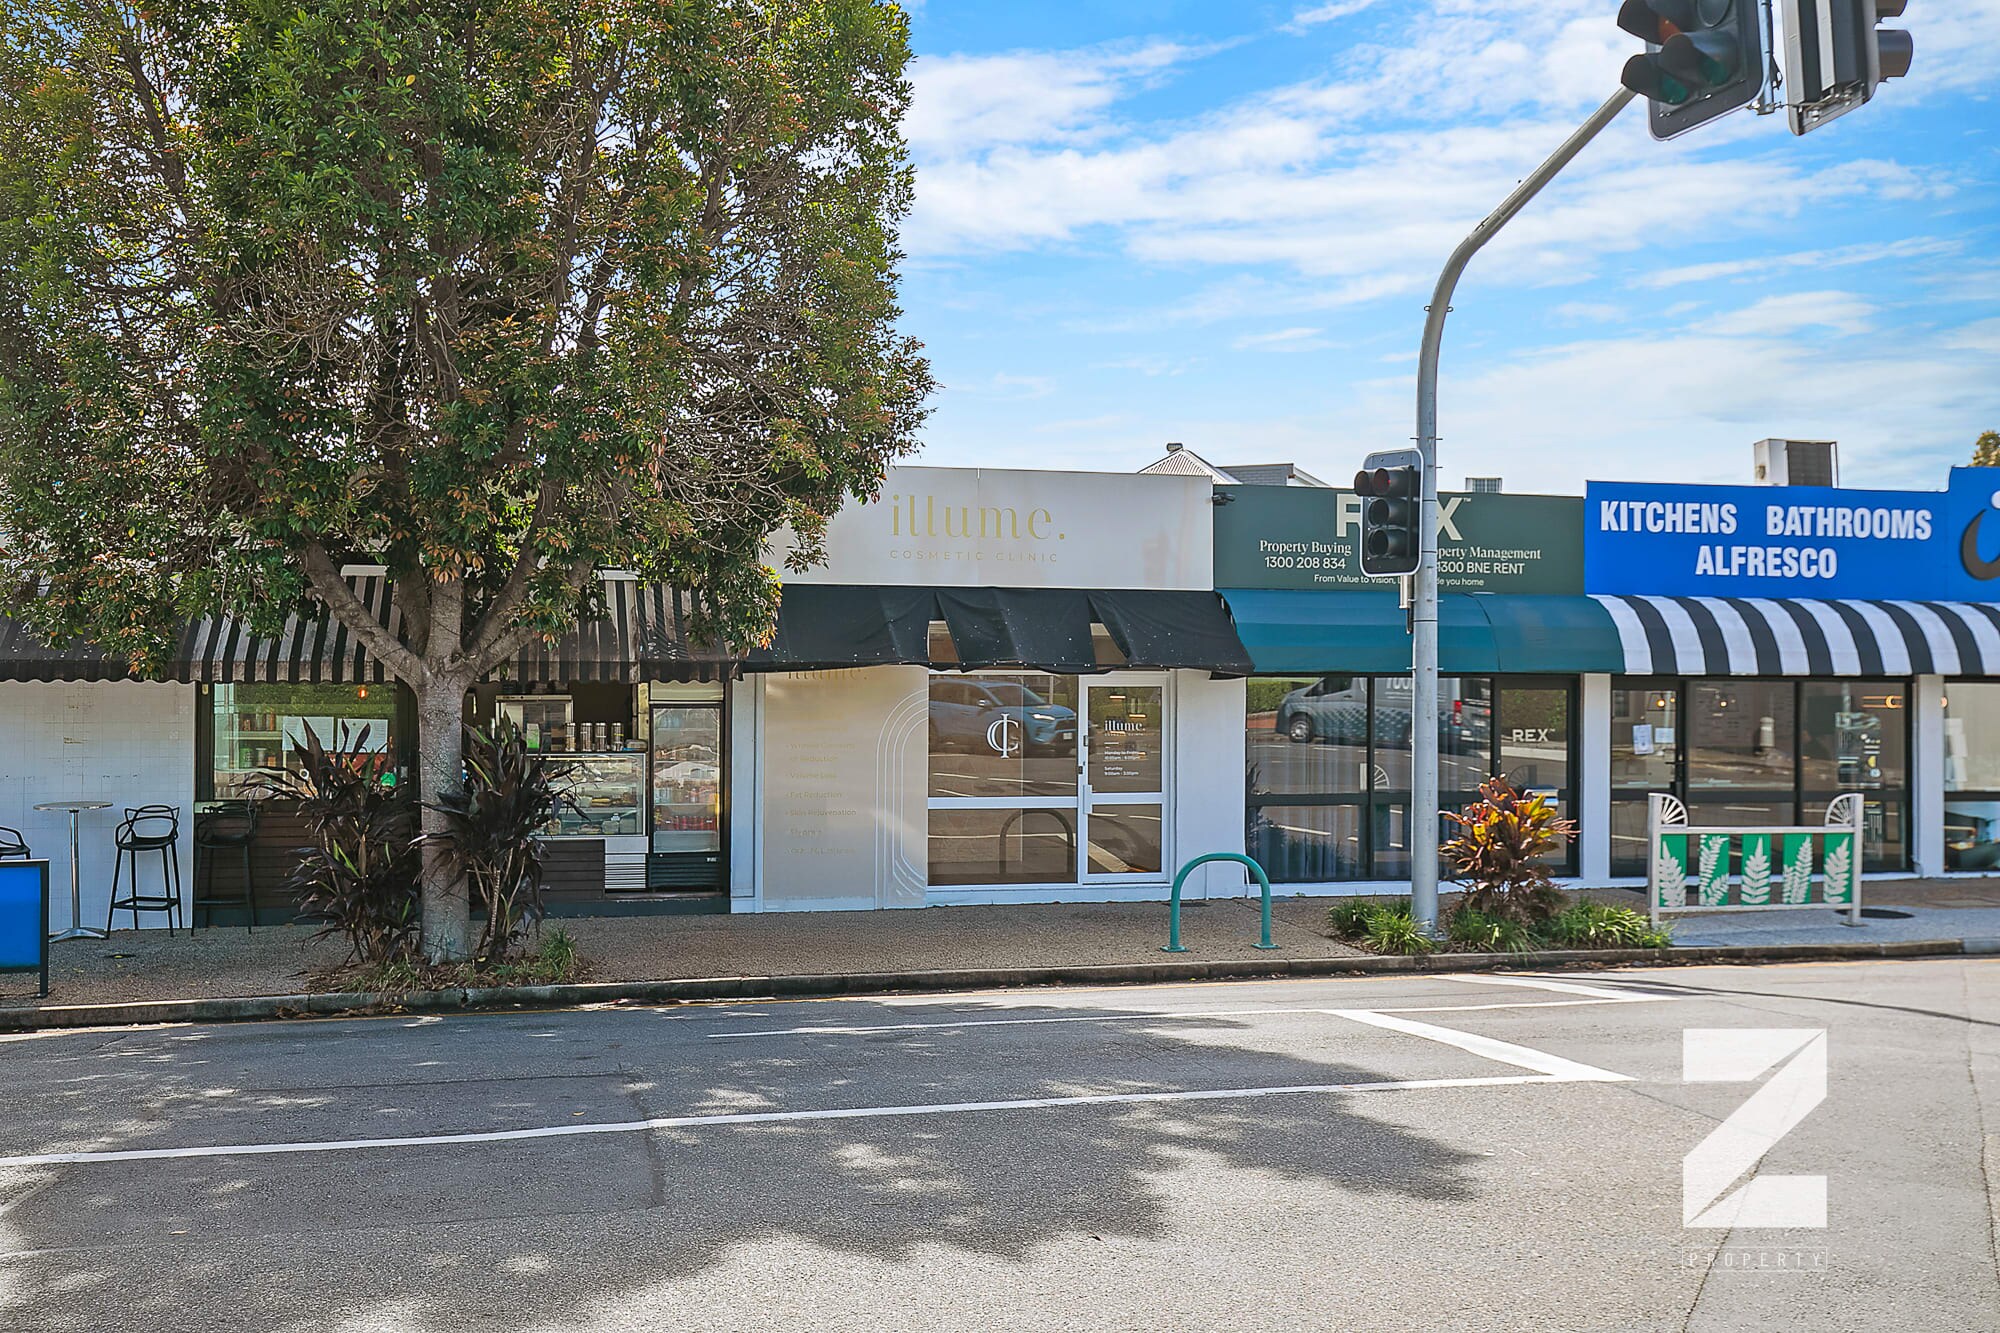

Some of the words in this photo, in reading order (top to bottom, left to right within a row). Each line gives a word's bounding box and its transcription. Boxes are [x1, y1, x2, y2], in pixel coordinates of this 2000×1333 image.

[893, 495, 1065, 541] illume.
[1600, 501, 1738, 534] KITCHENS
[1766, 506, 1932, 540] BATHROOMS
[1259, 540, 1309, 556] Property
[1311, 542, 1352, 557] Buying
[1438, 547, 1468, 560] perty
[1469, 546, 1541, 561] Management
[890, 549, 985, 561] COSMETIC
[995, 551, 1058, 563] CLINIC
[1264, 556, 1294, 569] 1300
[1296, 557, 1321, 570] 208
[1322, 557, 1346, 570] 834
[1695, 546, 1837, 579] ALFRESCO
[1466, 562, 1491, 574] BNE
[1493, 562, 1526, 575] RENT
[1314, 574, 1336, 584] From
[1337, 574, 1359, 584] Value
[1360, 576, 1368, 585] to
[1369, 575, 1397, 586] Vision,
[1446, 579, 1461, 587] you
[1462, 577, 1484, 586] home
